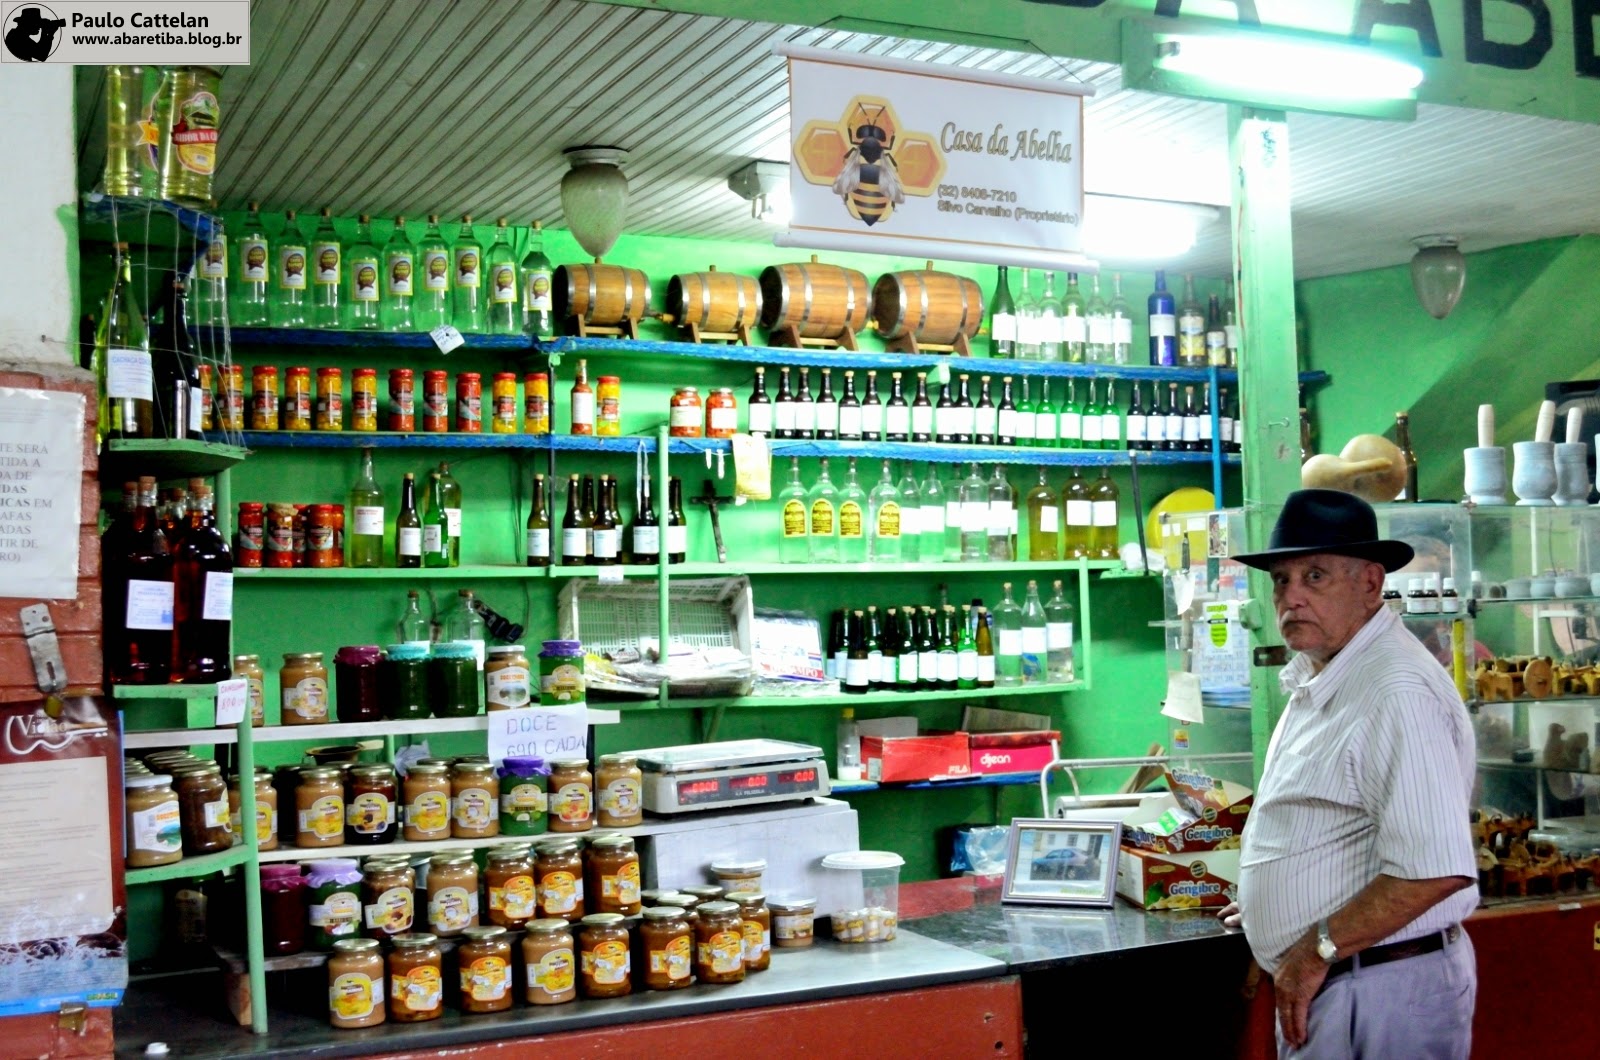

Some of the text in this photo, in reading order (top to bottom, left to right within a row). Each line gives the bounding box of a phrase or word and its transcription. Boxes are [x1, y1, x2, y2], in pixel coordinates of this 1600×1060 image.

[940, 121, 1072, 163] Casa da Abelha
[937, 184, 959, 200] (32)
[965, 202, 1012, 218] Carvalho
[32, 458, 41, 468] A
[15, 470, 32, 481] DE
[34, 498, 52, 509] EM
[21, 539, 39, 549] DE
[506, 714, 558, 736] DOCE
[544, 735, 586, 754] CADA
[948, 765, 969, 774] FILA
[1171, 768, 1214, 789] Gengibre
[1186, 827, 1232, 841] Gengibre
[1170, 882, 1220, 897] Gengibre
